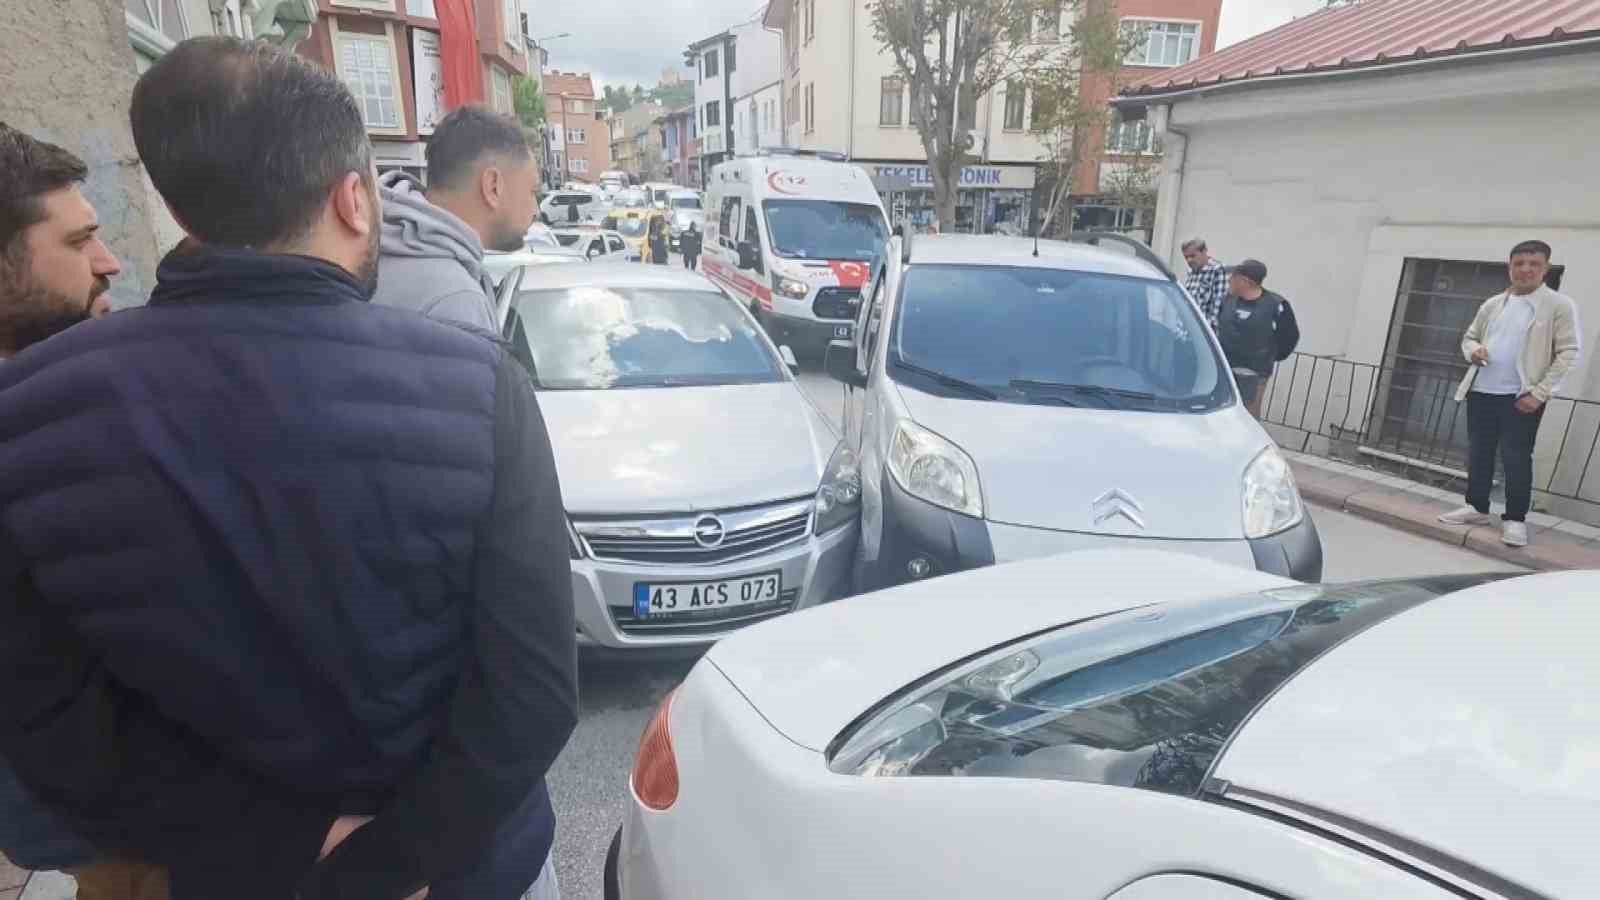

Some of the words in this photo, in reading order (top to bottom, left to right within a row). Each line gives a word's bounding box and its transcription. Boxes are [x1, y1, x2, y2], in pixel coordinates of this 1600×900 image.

[652, 588, 677, 609] 43
[690, 584, 728, 607] ACS
[741, 577, 776, 601] 073
